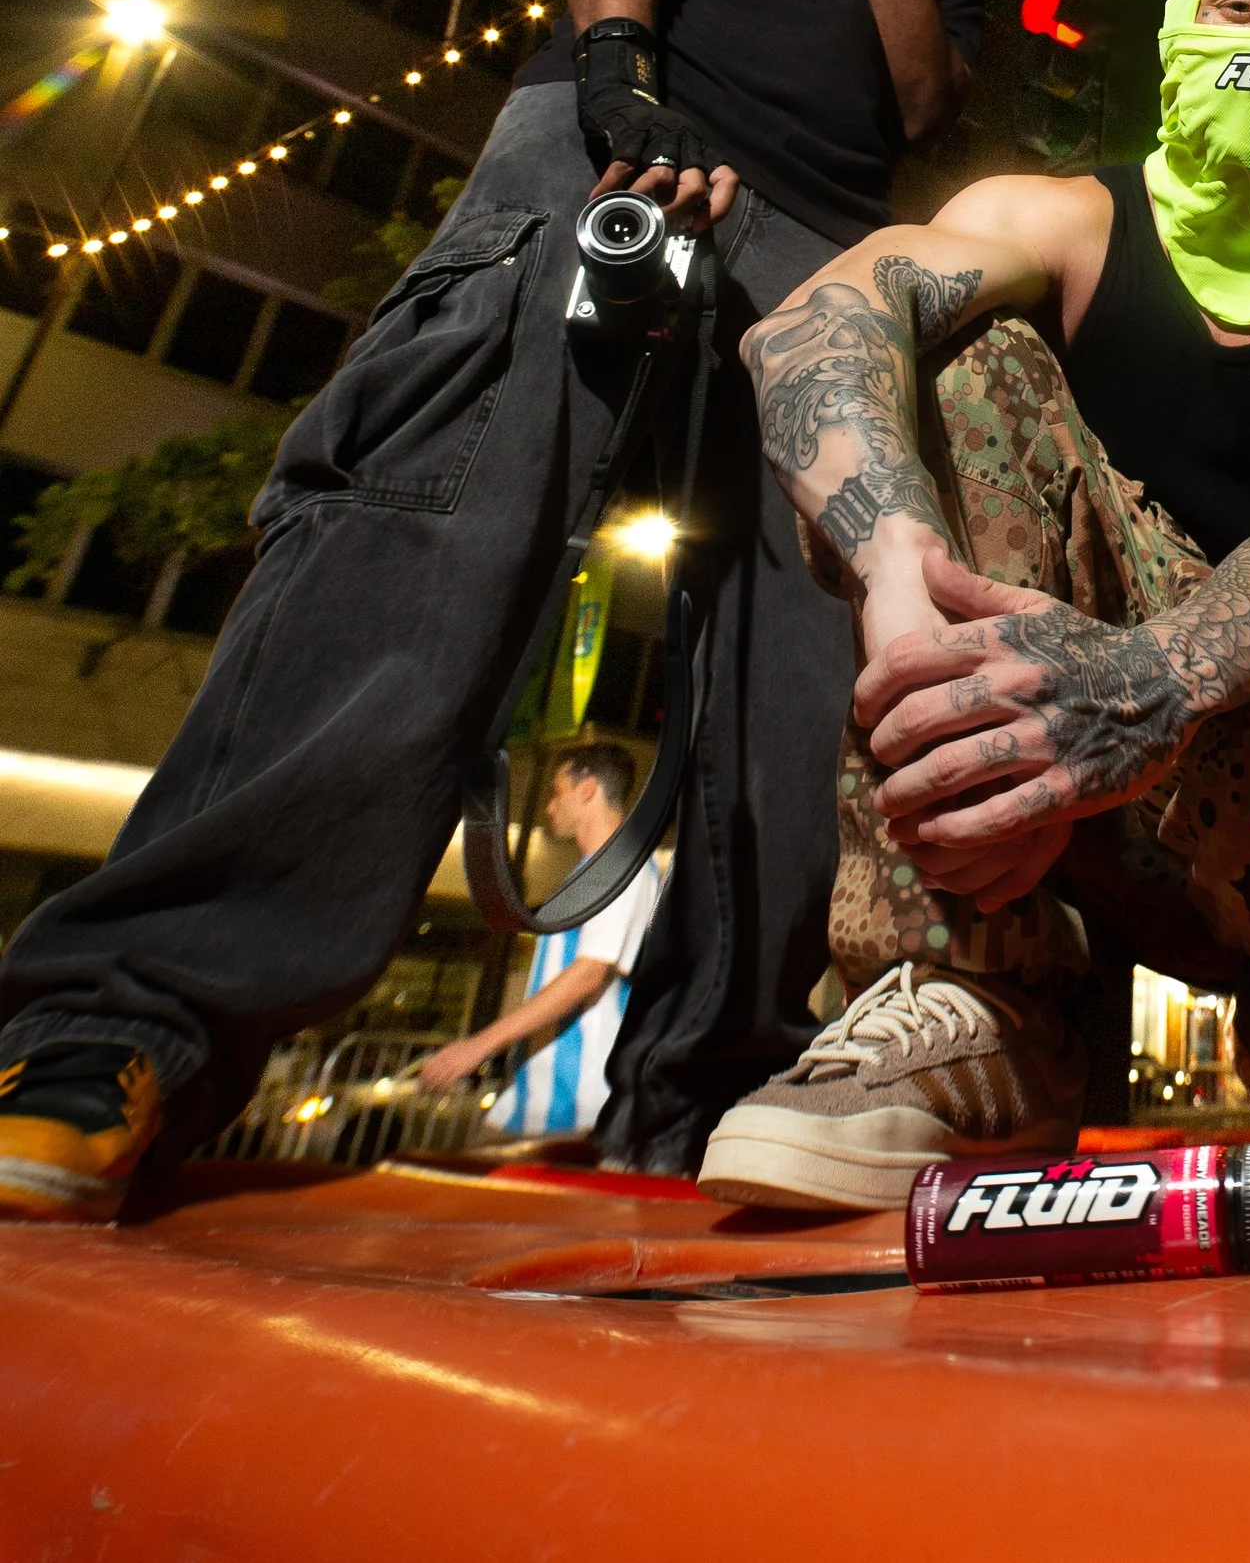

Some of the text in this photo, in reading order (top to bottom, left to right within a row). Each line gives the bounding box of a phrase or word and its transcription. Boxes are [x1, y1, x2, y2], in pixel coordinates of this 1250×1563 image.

[927, 1171, 944, 1244] ENERGY SYRUP
[946, 1163, 1159, 1232] FLUID
